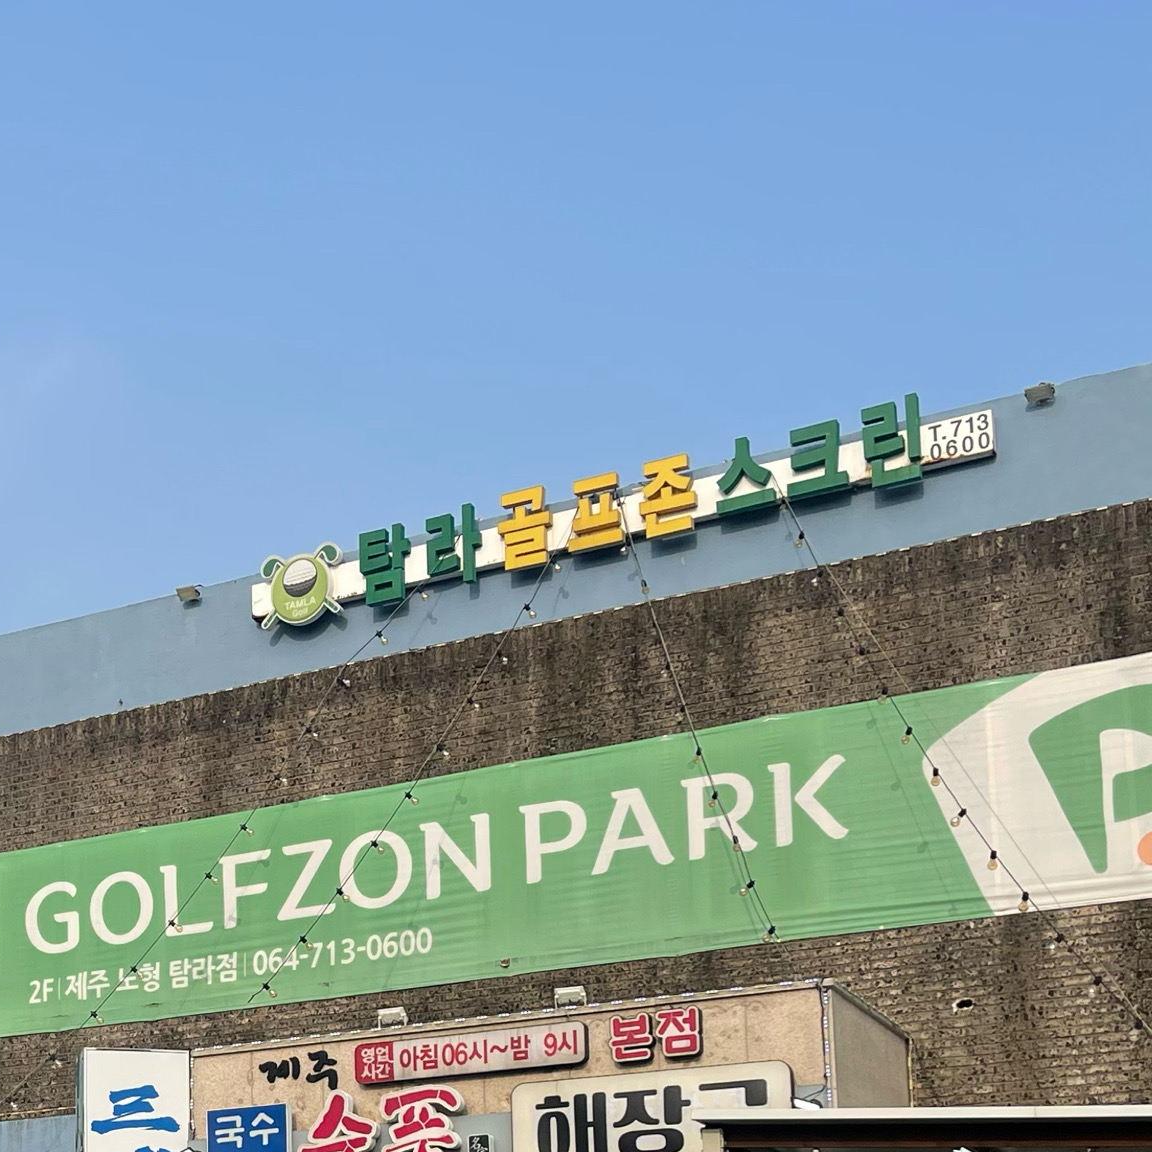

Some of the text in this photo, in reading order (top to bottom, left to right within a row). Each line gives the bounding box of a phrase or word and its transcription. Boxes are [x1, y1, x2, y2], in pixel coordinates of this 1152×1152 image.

[928, 414, 989, 442] T.713
[930, 432, 990, 460] 0600
[358, 393, 924, 607] 탐라 골프존 스크린
[285, 596, 316, 610] TAMLA
[292, 607, 308, 617] Golf
[25, 754, 849, 954] GOLFZON PARK
[29, 927, 433, 1004] 2F 제주 노형 탐라점 064-713-0600
[544, 1030, 578, 1056] 9시
[611, 1006, 699, 1061] 본점
[361, 1046, 392, 1063] 영업
[259, 1051, 337, 1090] 제주
[361, 1064, 391, 1080] 시간
[215, 1113, 279, 1148] 국수
